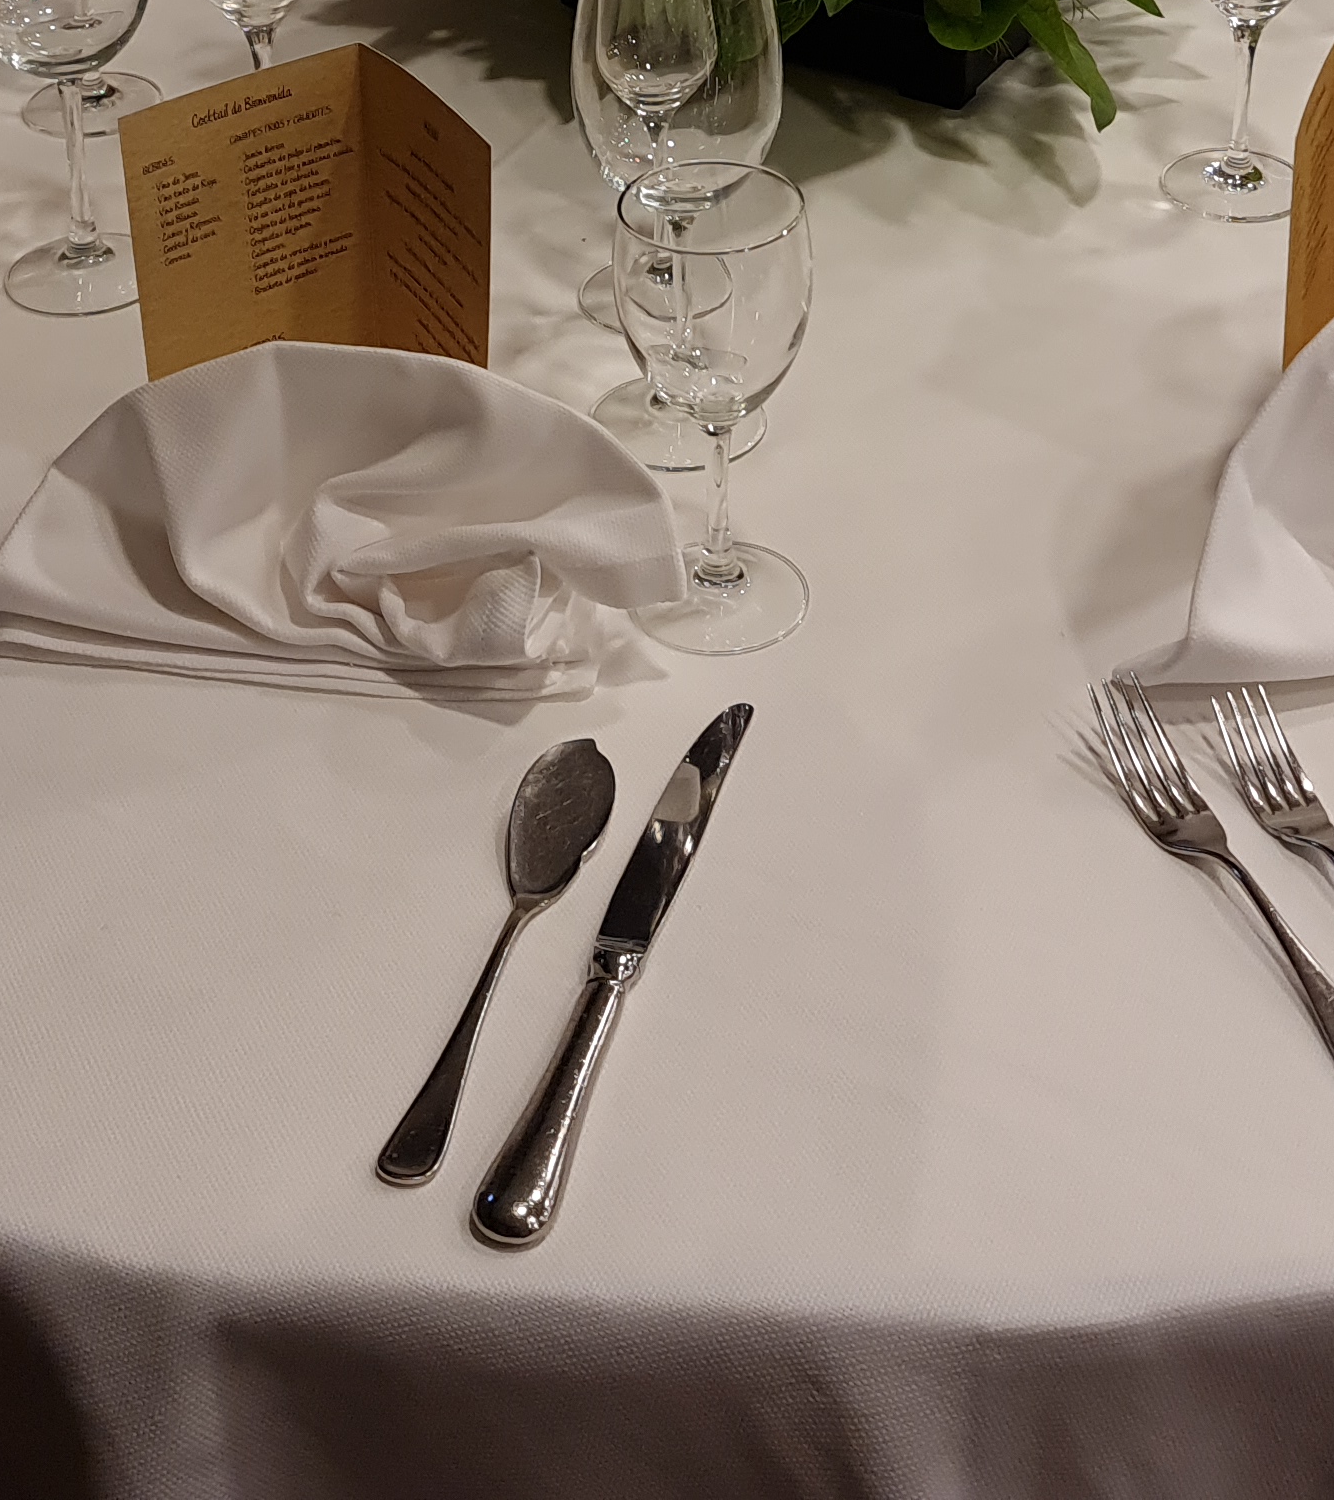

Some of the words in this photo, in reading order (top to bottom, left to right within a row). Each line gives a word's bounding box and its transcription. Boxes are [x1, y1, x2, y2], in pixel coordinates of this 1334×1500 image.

[191, 102, 229, 128] Cocktail
[231, 100, 242, 115] de
[243, 85, 292, 111] Bienvenida
